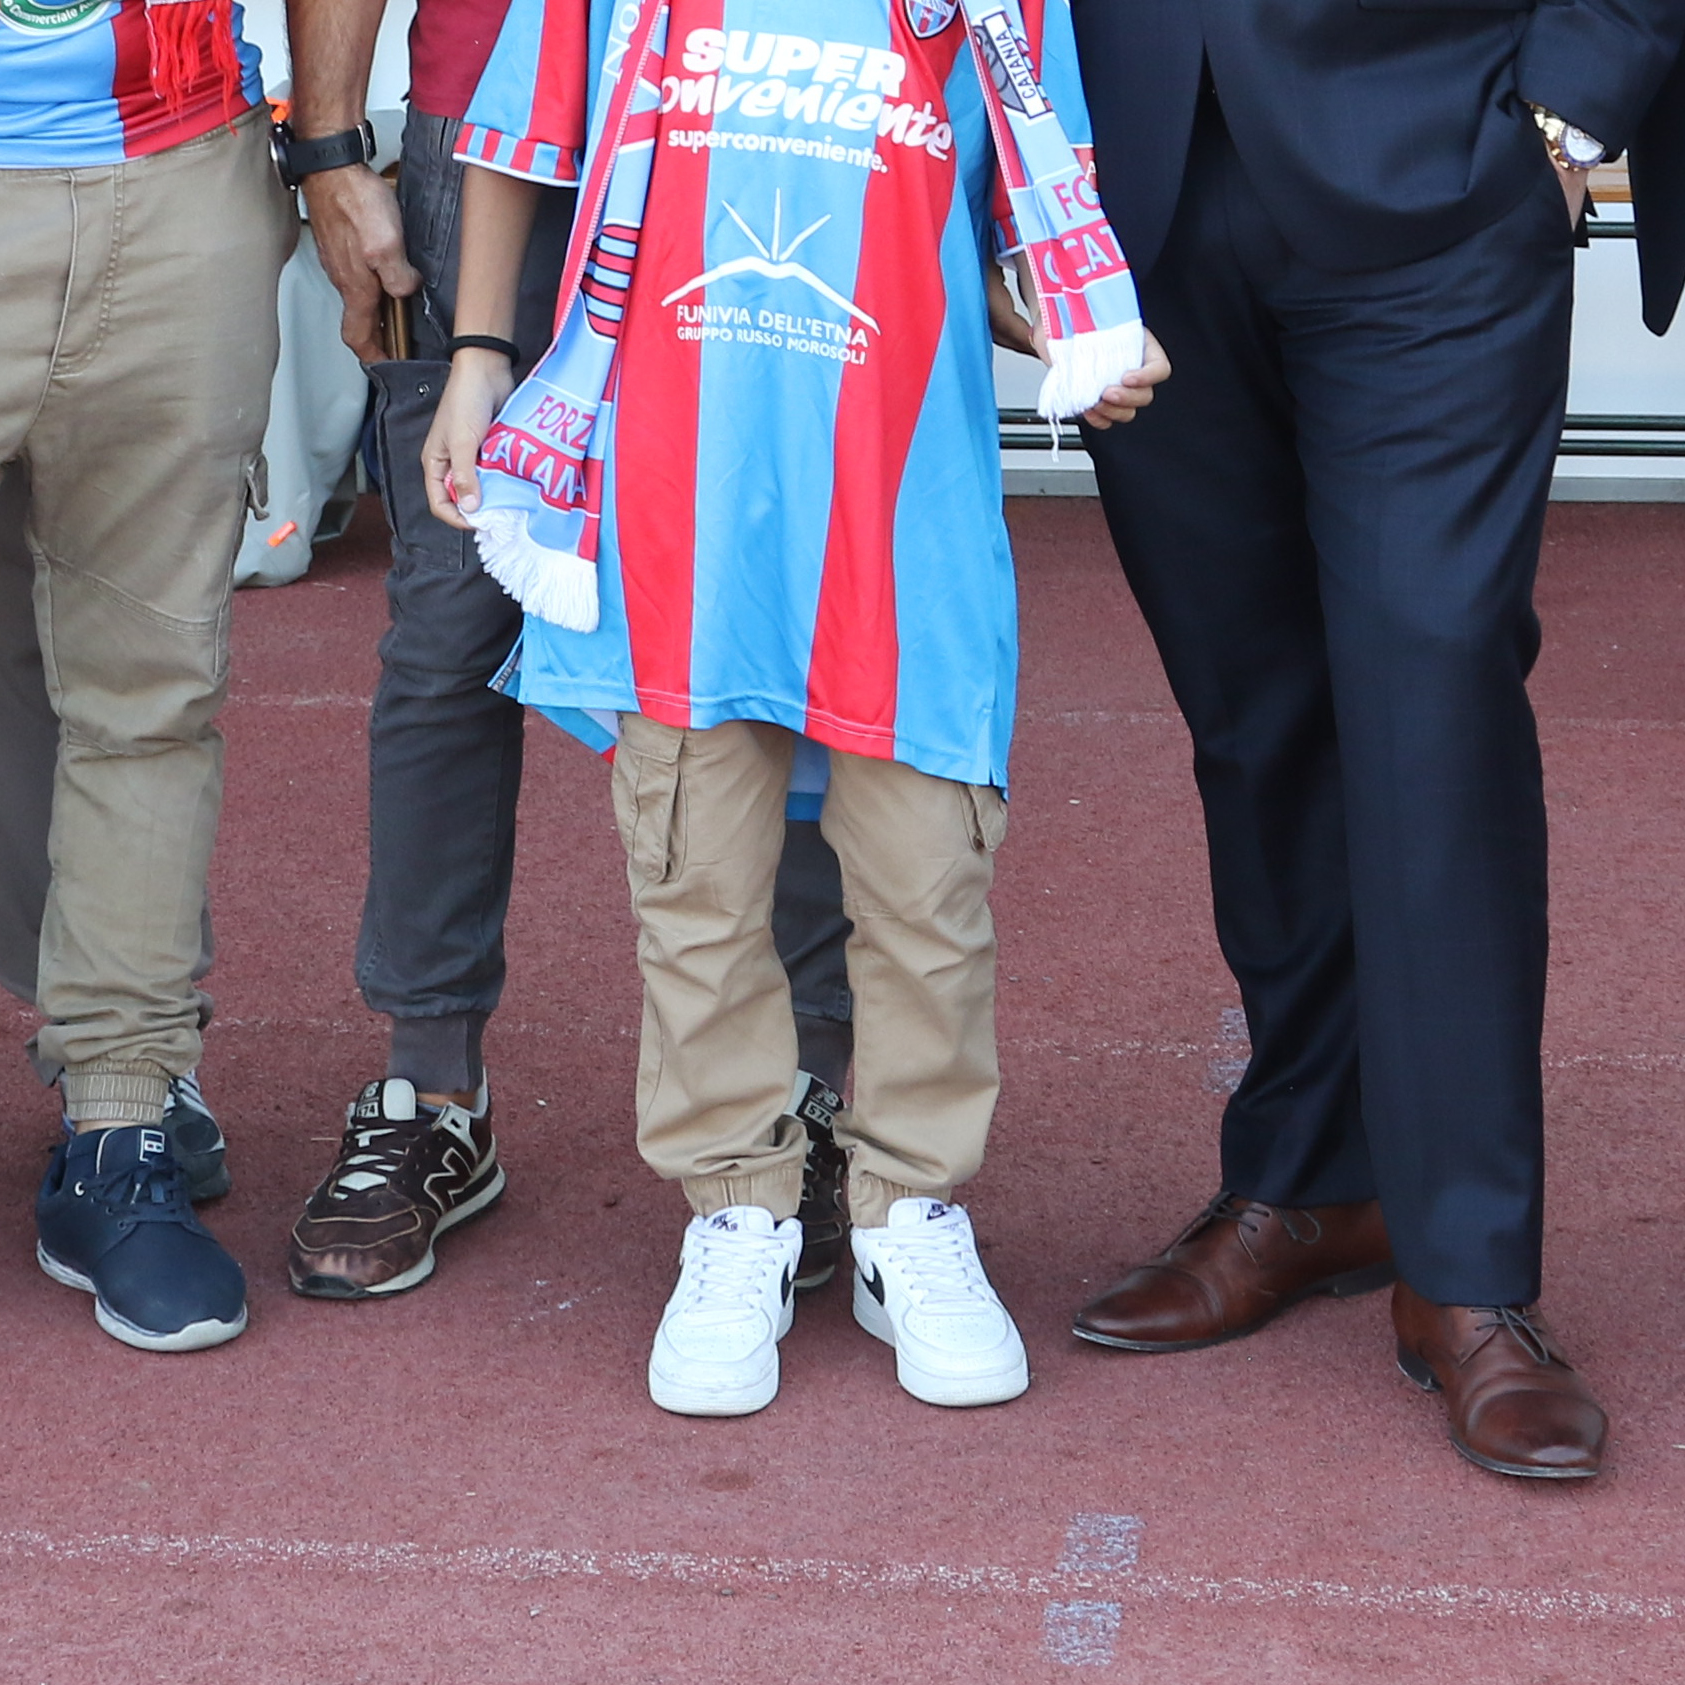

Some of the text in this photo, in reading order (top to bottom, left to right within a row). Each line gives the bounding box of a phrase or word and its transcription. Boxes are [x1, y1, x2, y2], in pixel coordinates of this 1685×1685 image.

[9, 3, 79, 25] Commerciale
[681, 27, 907, 99] SUPER
[995, 29, 1036, 100] CATANIA
[660, 74, 953, 161] onveniente
[676, 304, 869, 348] FUNIVIA DELL'ETNA
[676, 325, 866, 365] GRUPPO RUSSO MOROSOLI
[807, 1103, 832, 1127] 574
